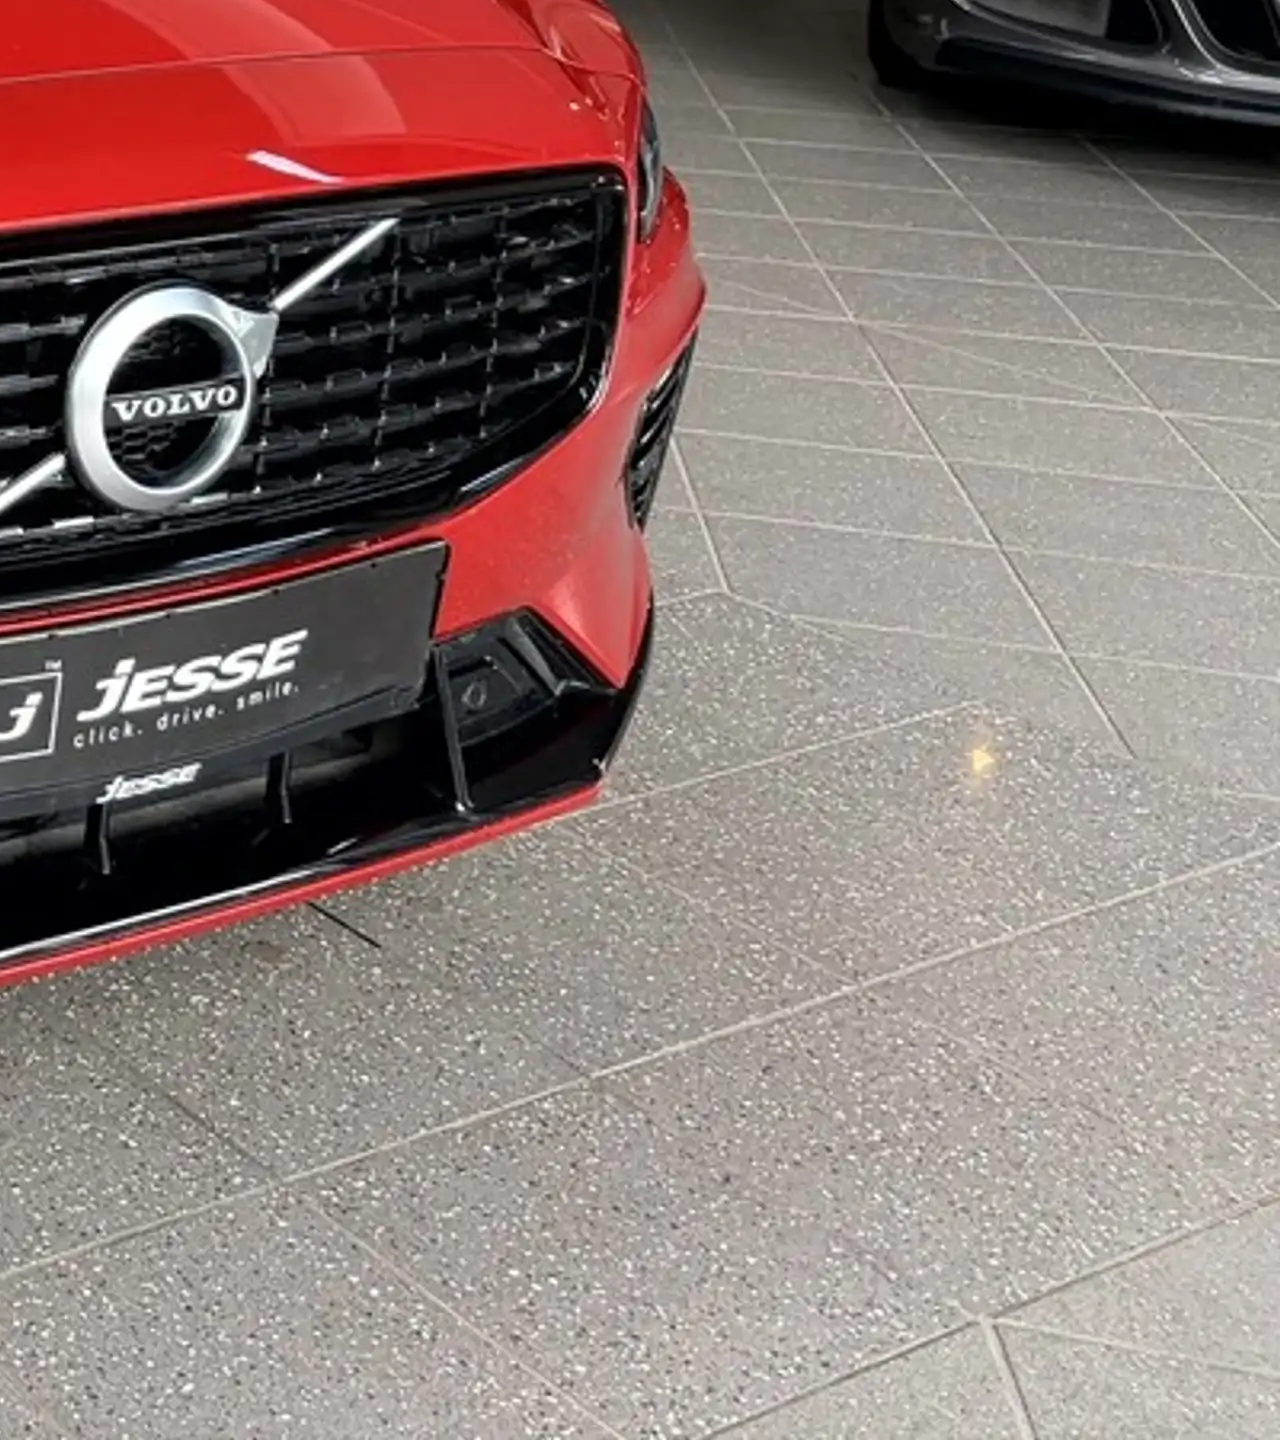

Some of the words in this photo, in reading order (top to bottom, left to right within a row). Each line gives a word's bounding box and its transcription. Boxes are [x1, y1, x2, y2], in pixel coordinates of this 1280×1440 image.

[112, 383, 239, 422] VOLVO
[72, 718, 144, 749] click.
[155, 702, 225, 731] drive.
[235, 680, 300, 712] smile.
